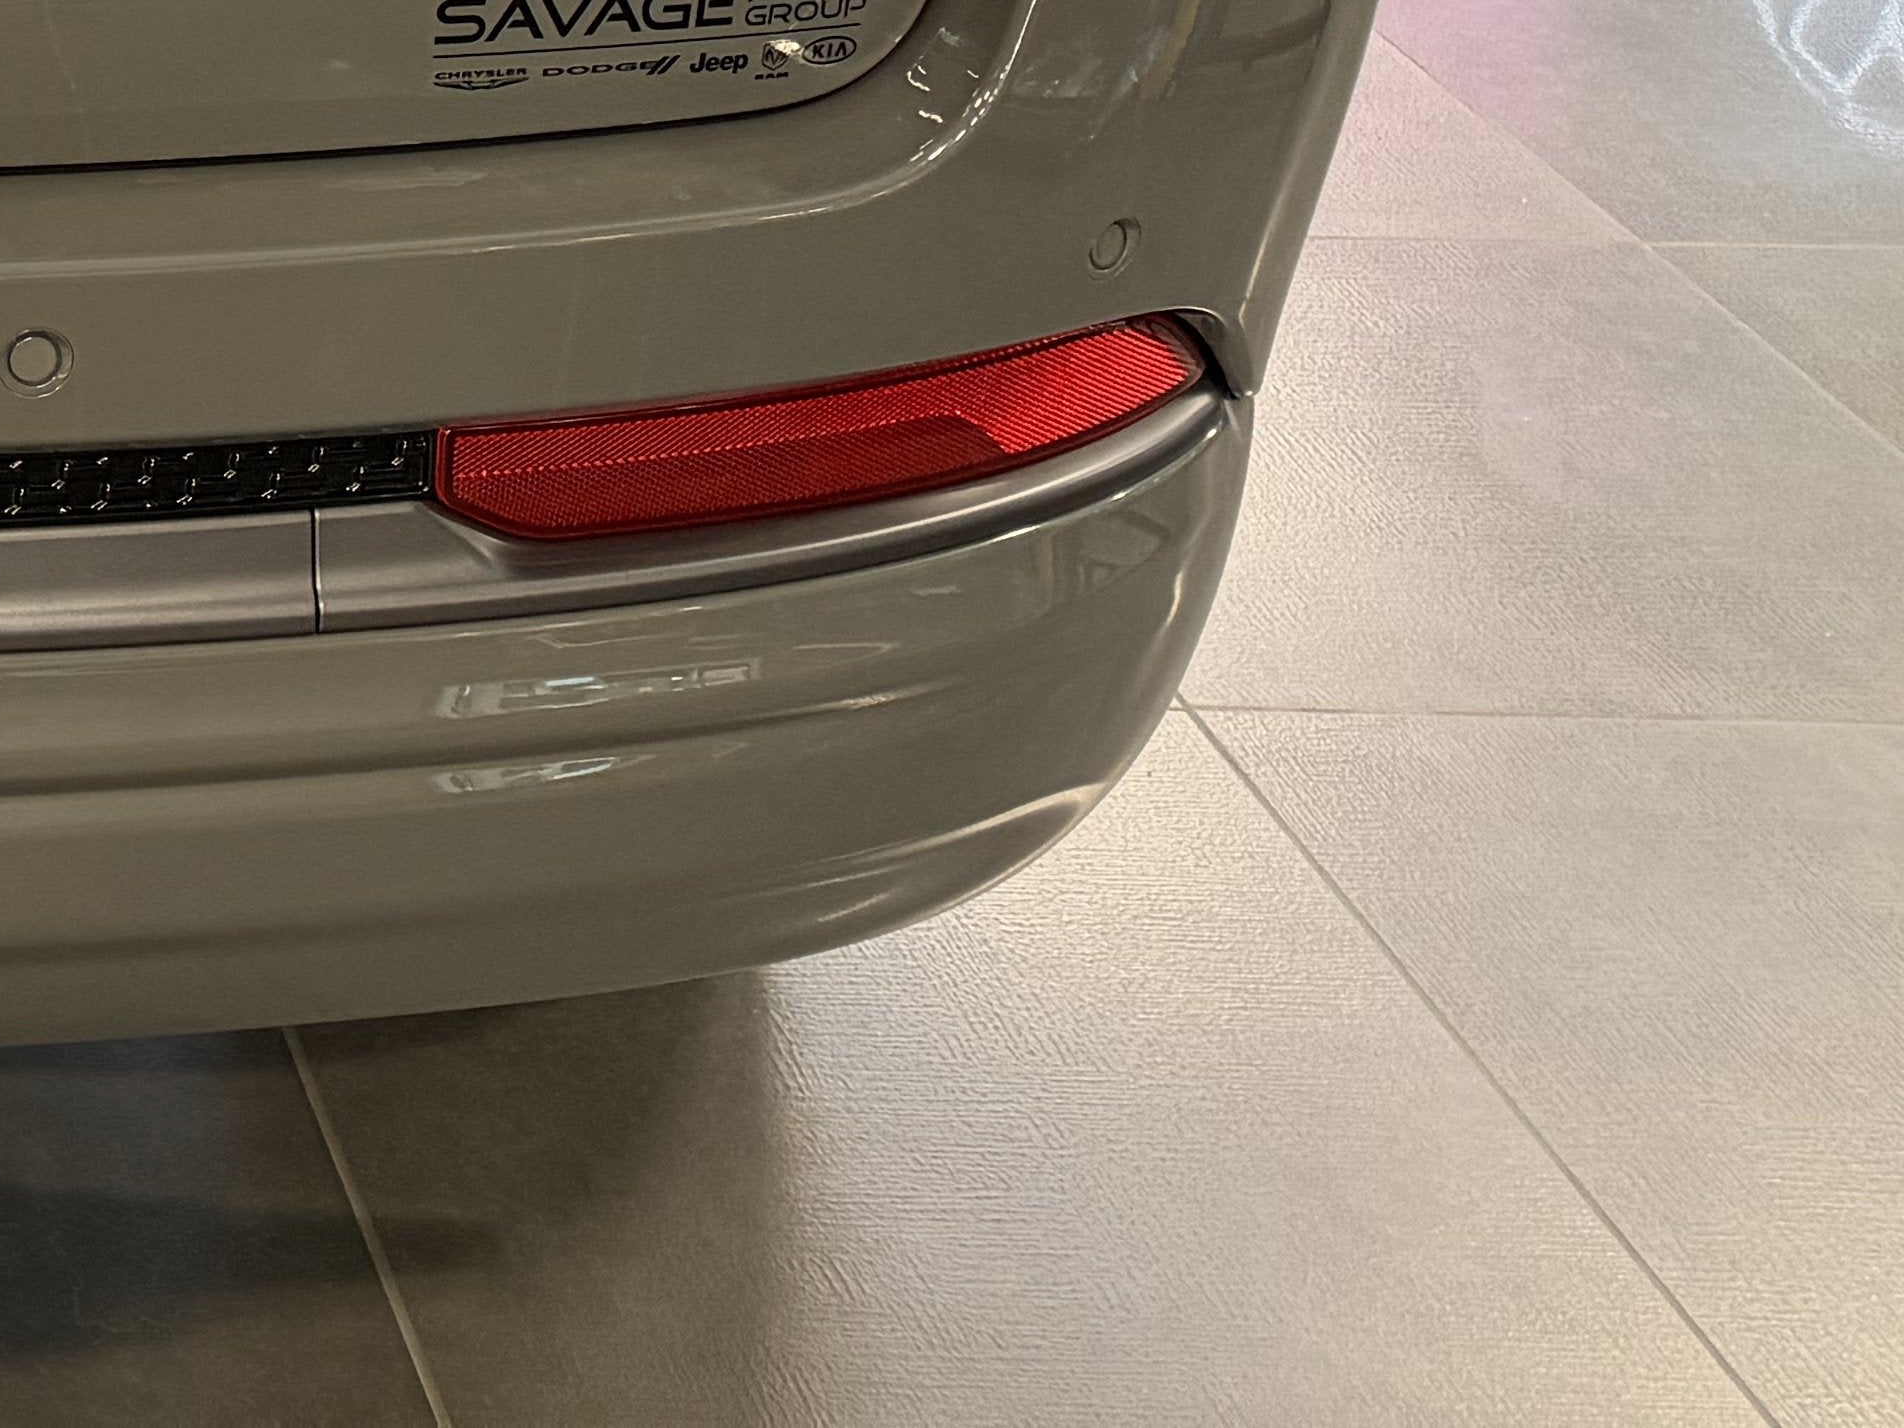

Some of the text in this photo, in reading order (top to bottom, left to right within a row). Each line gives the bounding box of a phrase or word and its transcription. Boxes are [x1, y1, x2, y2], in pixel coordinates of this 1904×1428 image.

[542, 60, 658, 77] DODGE
[689, 52, 749, 74] Jeep
[434, 67, 529, 81] CHRYSLER
